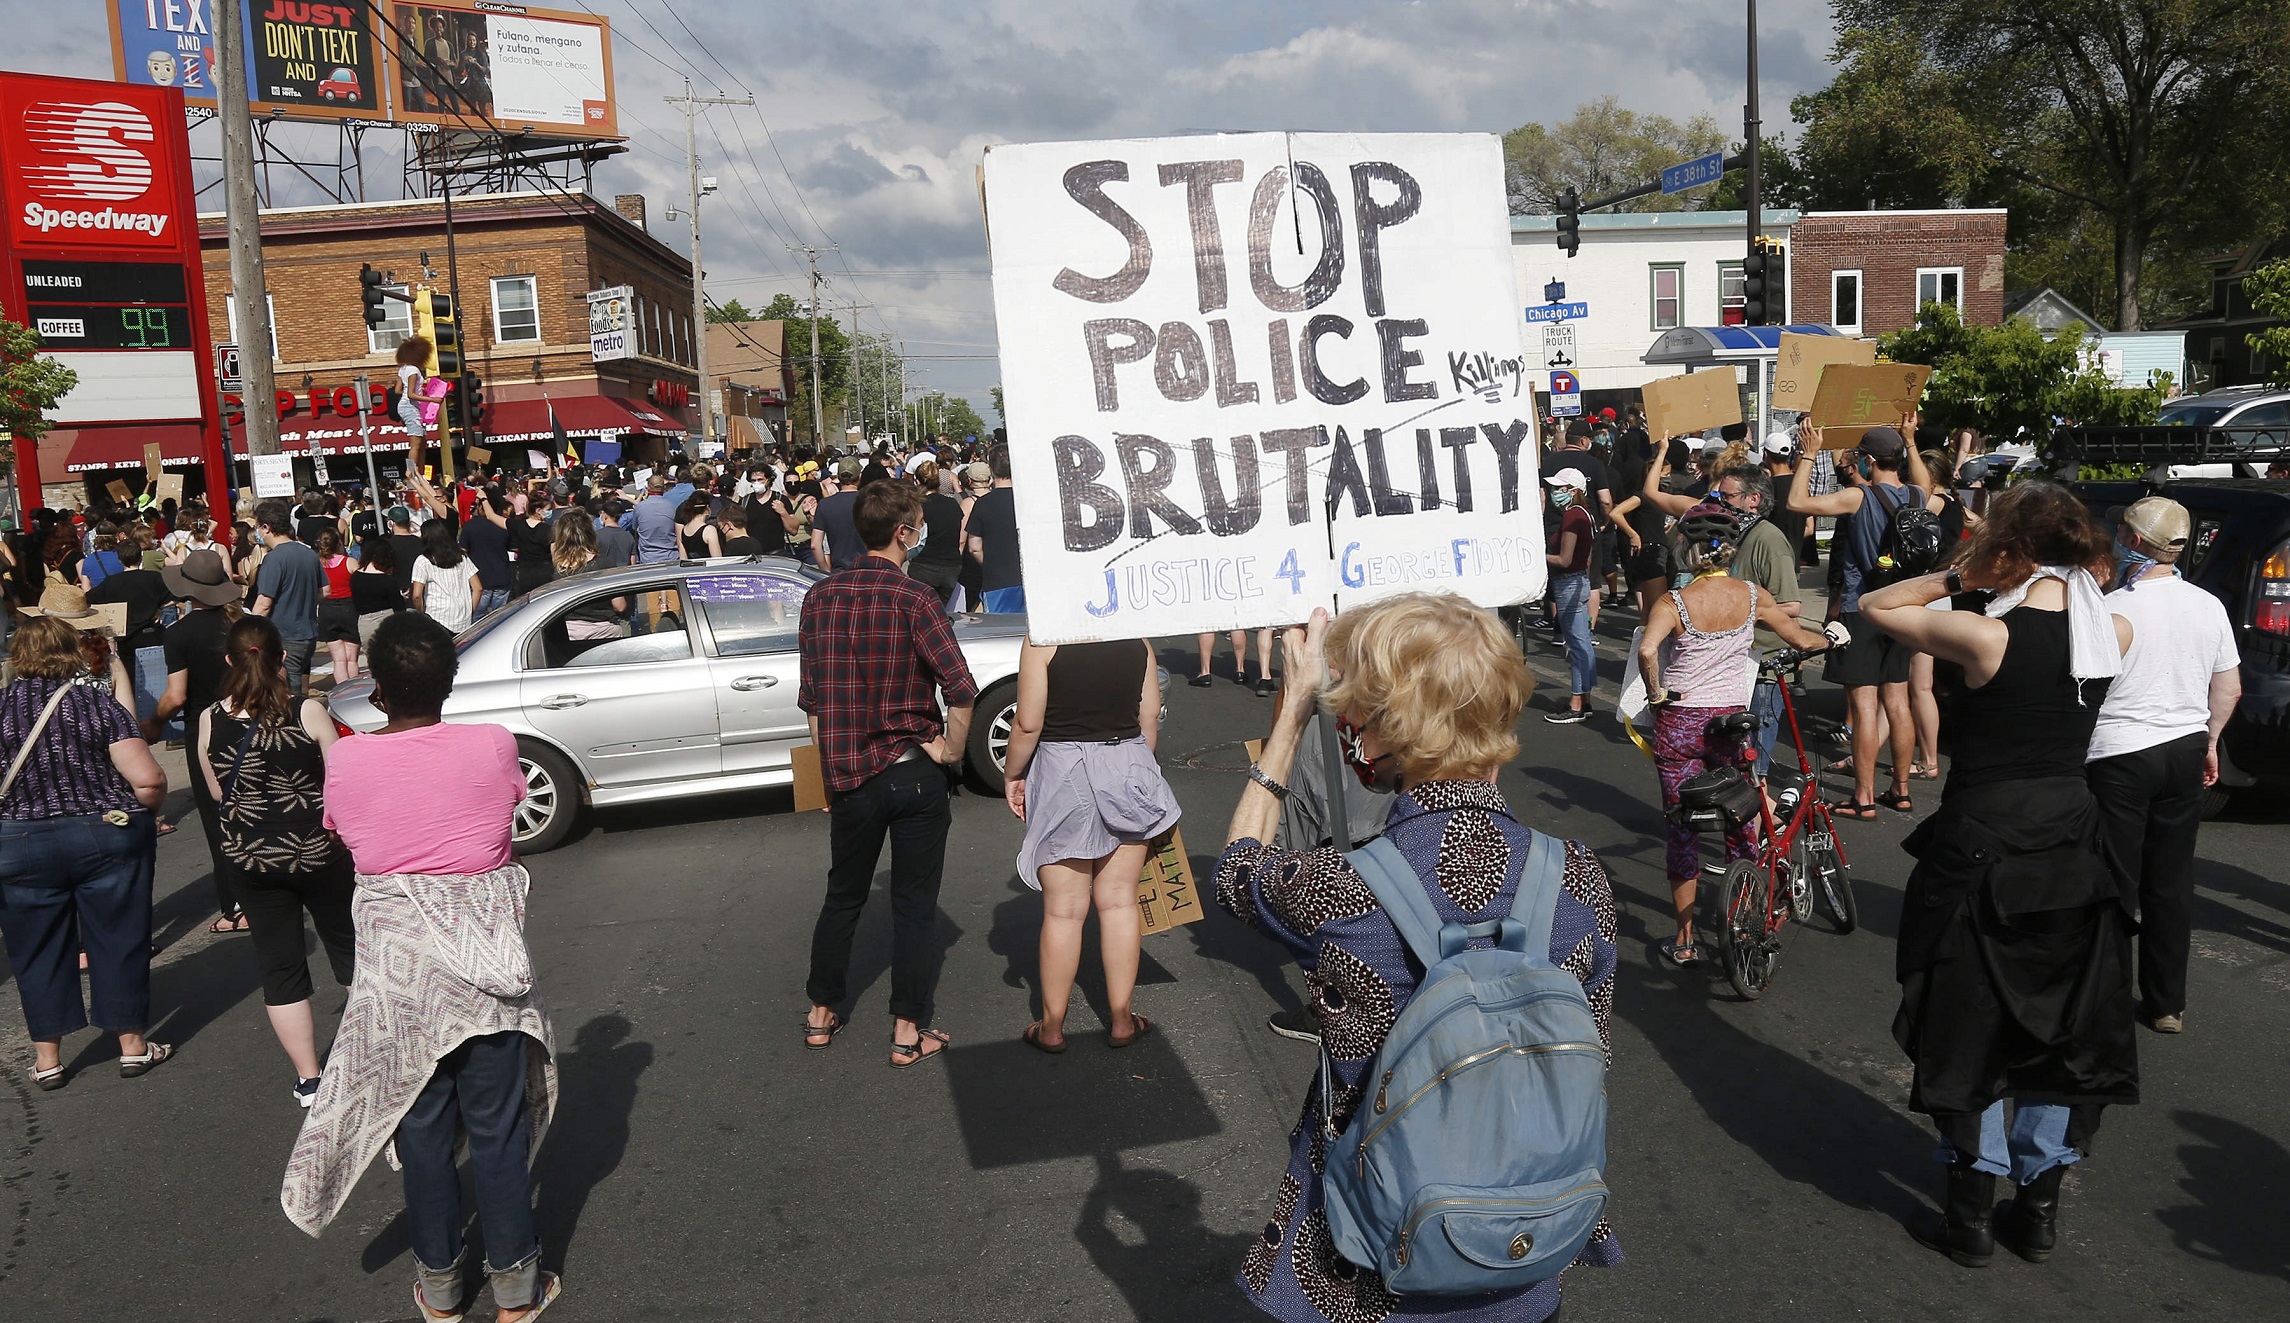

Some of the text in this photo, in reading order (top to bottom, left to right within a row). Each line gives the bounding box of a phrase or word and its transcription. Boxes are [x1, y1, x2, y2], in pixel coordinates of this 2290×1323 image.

[145, 0, 209, 34] TEX
[264, 0, 356, 27] JUST
[177, 34, 200, 52] AND
[265, 22, 358, 65] DON'T TEXT
[497, 30, 582, 48] Fulano, mengano
[498, 43, 542, 56] y zutana.
[286, 62, 316, 81] AND
[499, 54, 589, 71] Todos a llenar el censo.
[355, 119, 369, 127] Clear
[406, 122, 439, 133] 032570
[1674, 159, 1721, 187] E 38th St
[23, 202, 168, 237] Speedway
[1052, 159, 1422, 318] STOP
[25, 275, 82, 288] UNLEADED
[1528, 305, 1585, 321] Chicago Av
[41, 322, 82, 334] COFFEE
[590, 317, 611, 334] Foods
[1545, 326, 1572, 337] TRUCK
[593, 333, 624, 353] metro
[1545, 336, 1573, 346] ROUTE
[1083, 314, 1439, 412] POLICE
[1447, 350, 1526, 398] Killings
[223, 390, 296, 425] CP
[305, 428, 353, 440] Meat
[566, 428, 600, 437] HALAL
[300, 446, 336, 458] CADS
[343, 442, 390, 455] ORGNIC
[392, 441, 412, 451] MIL
[67, 456, 199, 472] STAMPS KEYS ONES &
[1052, 419, 1529, 552] BRUTALITY
[1084, 556, 1264, 618] JUSTICE
[1274, 548, 1306, 595] 4
[1340, 541, 1451, 590] GEORGE
